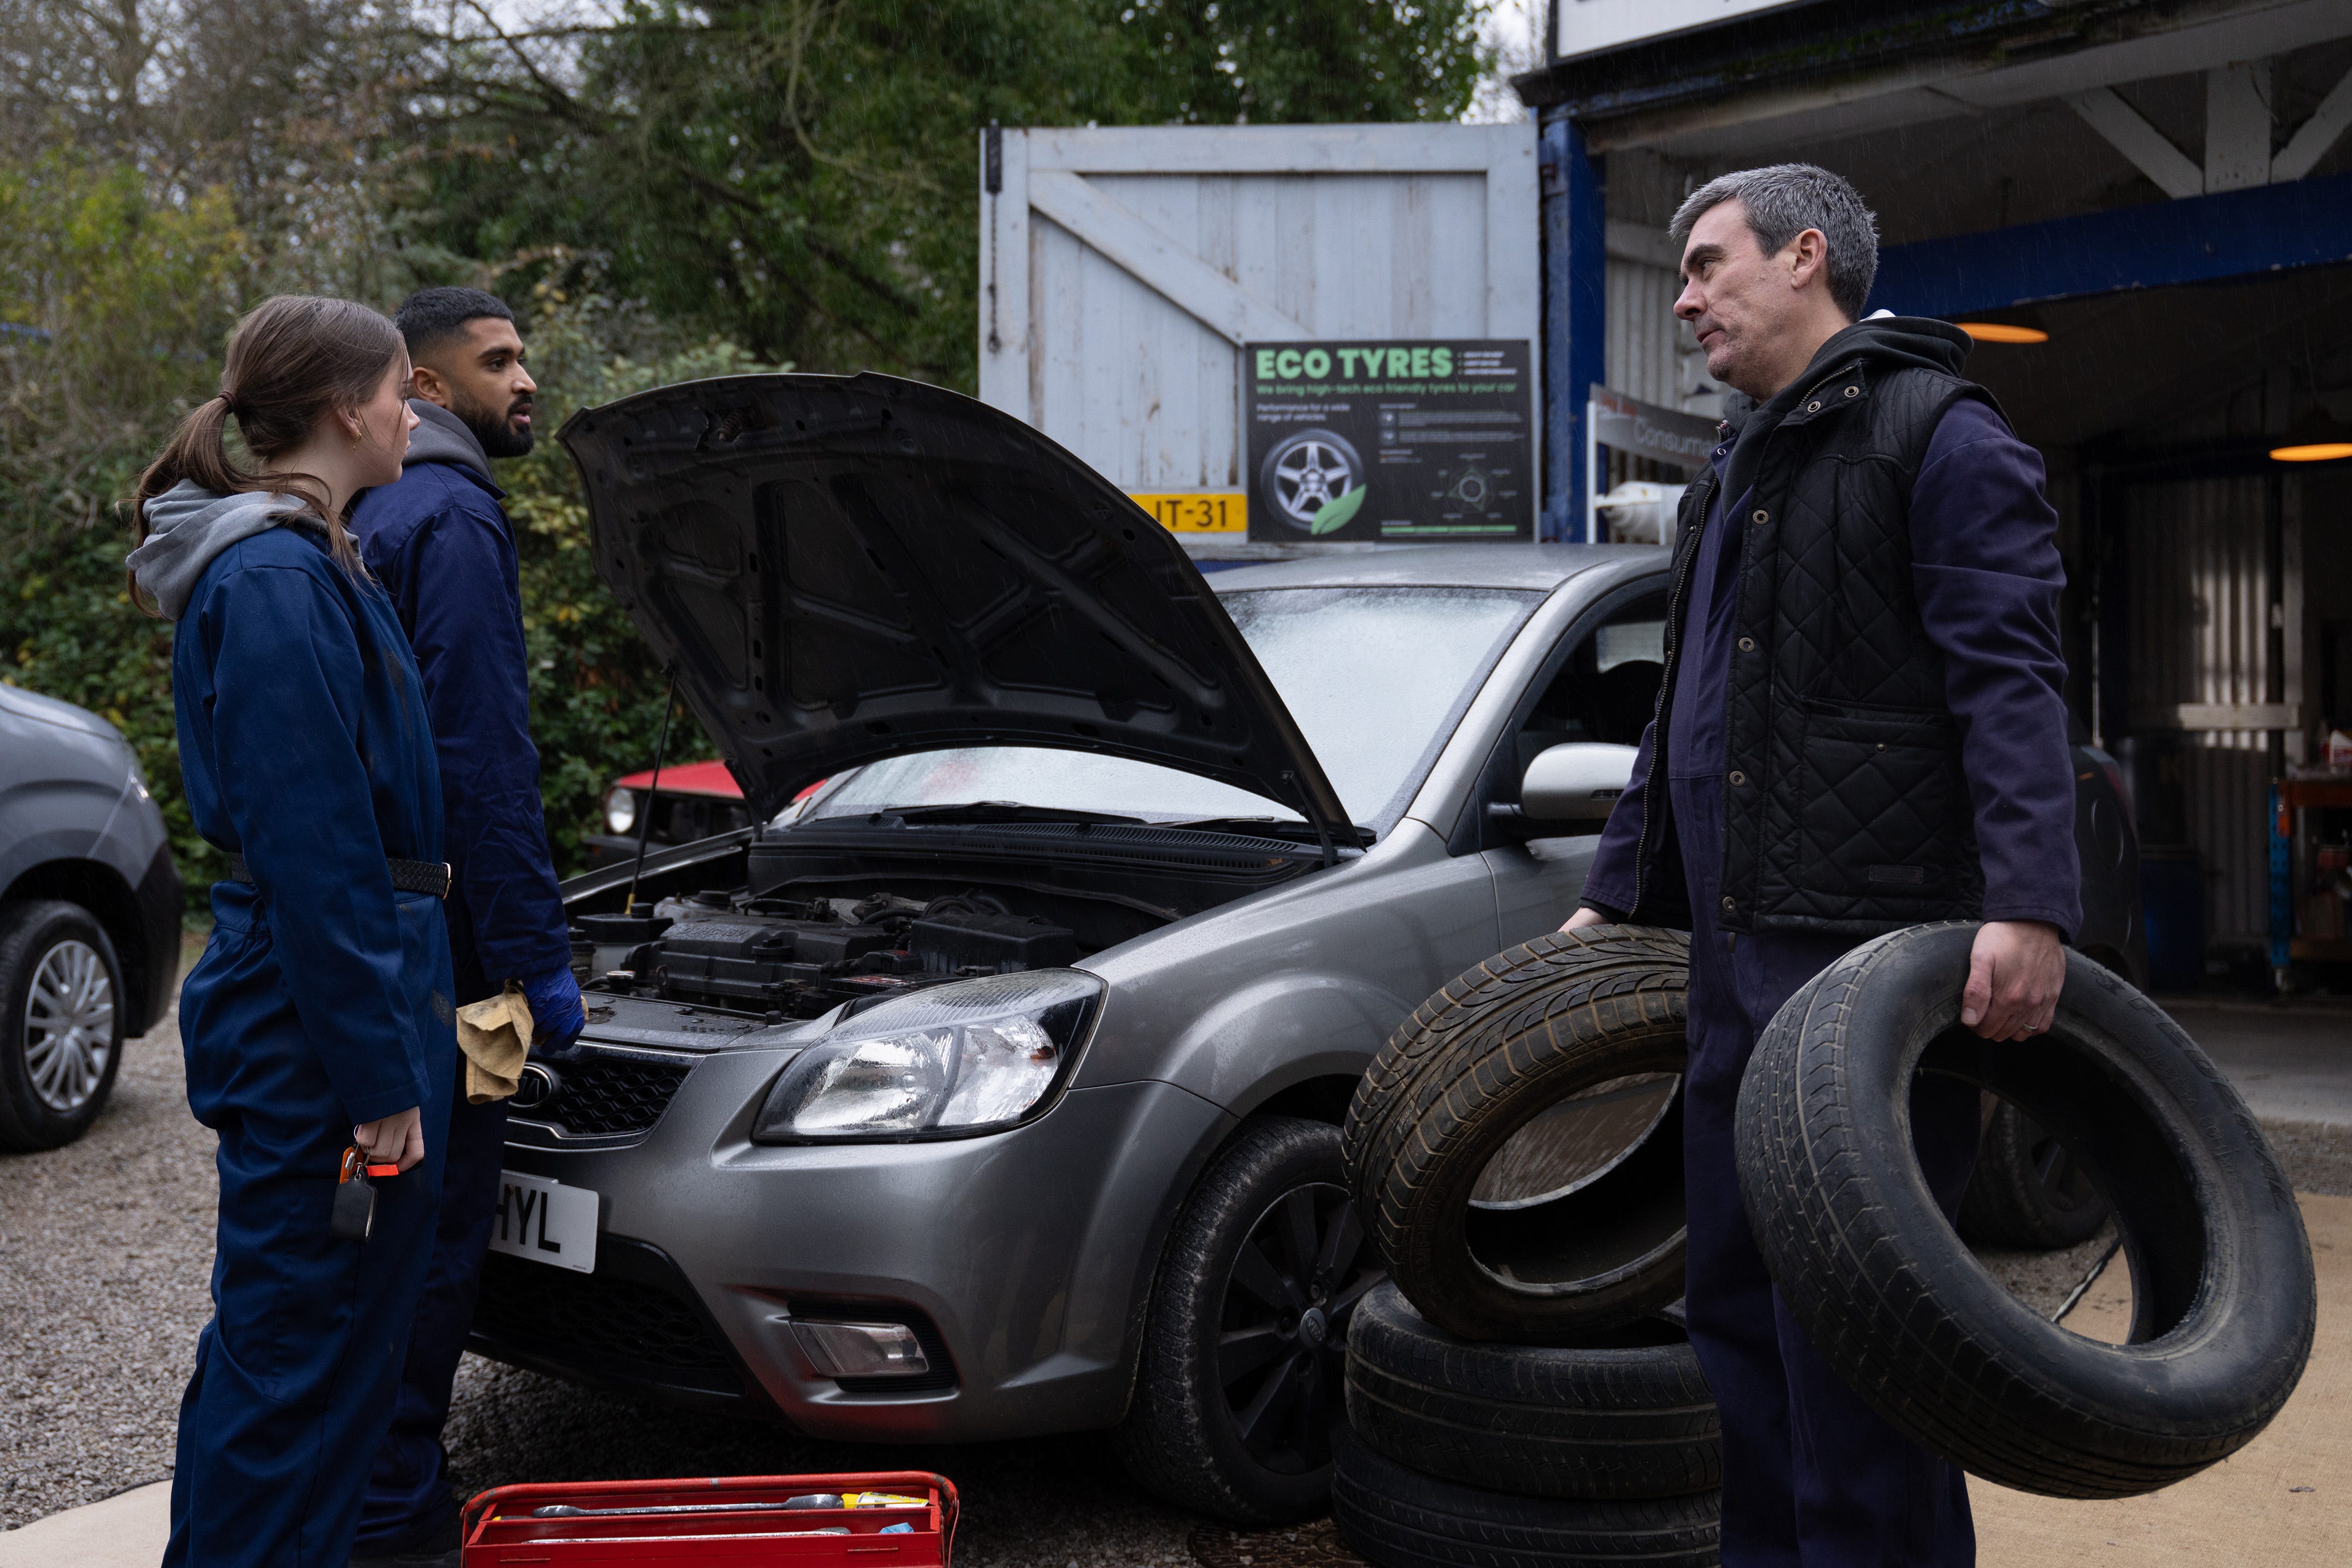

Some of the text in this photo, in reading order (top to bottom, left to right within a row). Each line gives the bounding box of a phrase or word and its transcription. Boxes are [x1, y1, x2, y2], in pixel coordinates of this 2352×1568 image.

[1256, 346, 1453, 379] ECO TYRES
[1256, 382, 1517, 397] We bring high-tech eco friendly tyres to your car
[680, 926, 722, 935] DOHC
[2128, 997, 2290, 1211] FEDERAL
